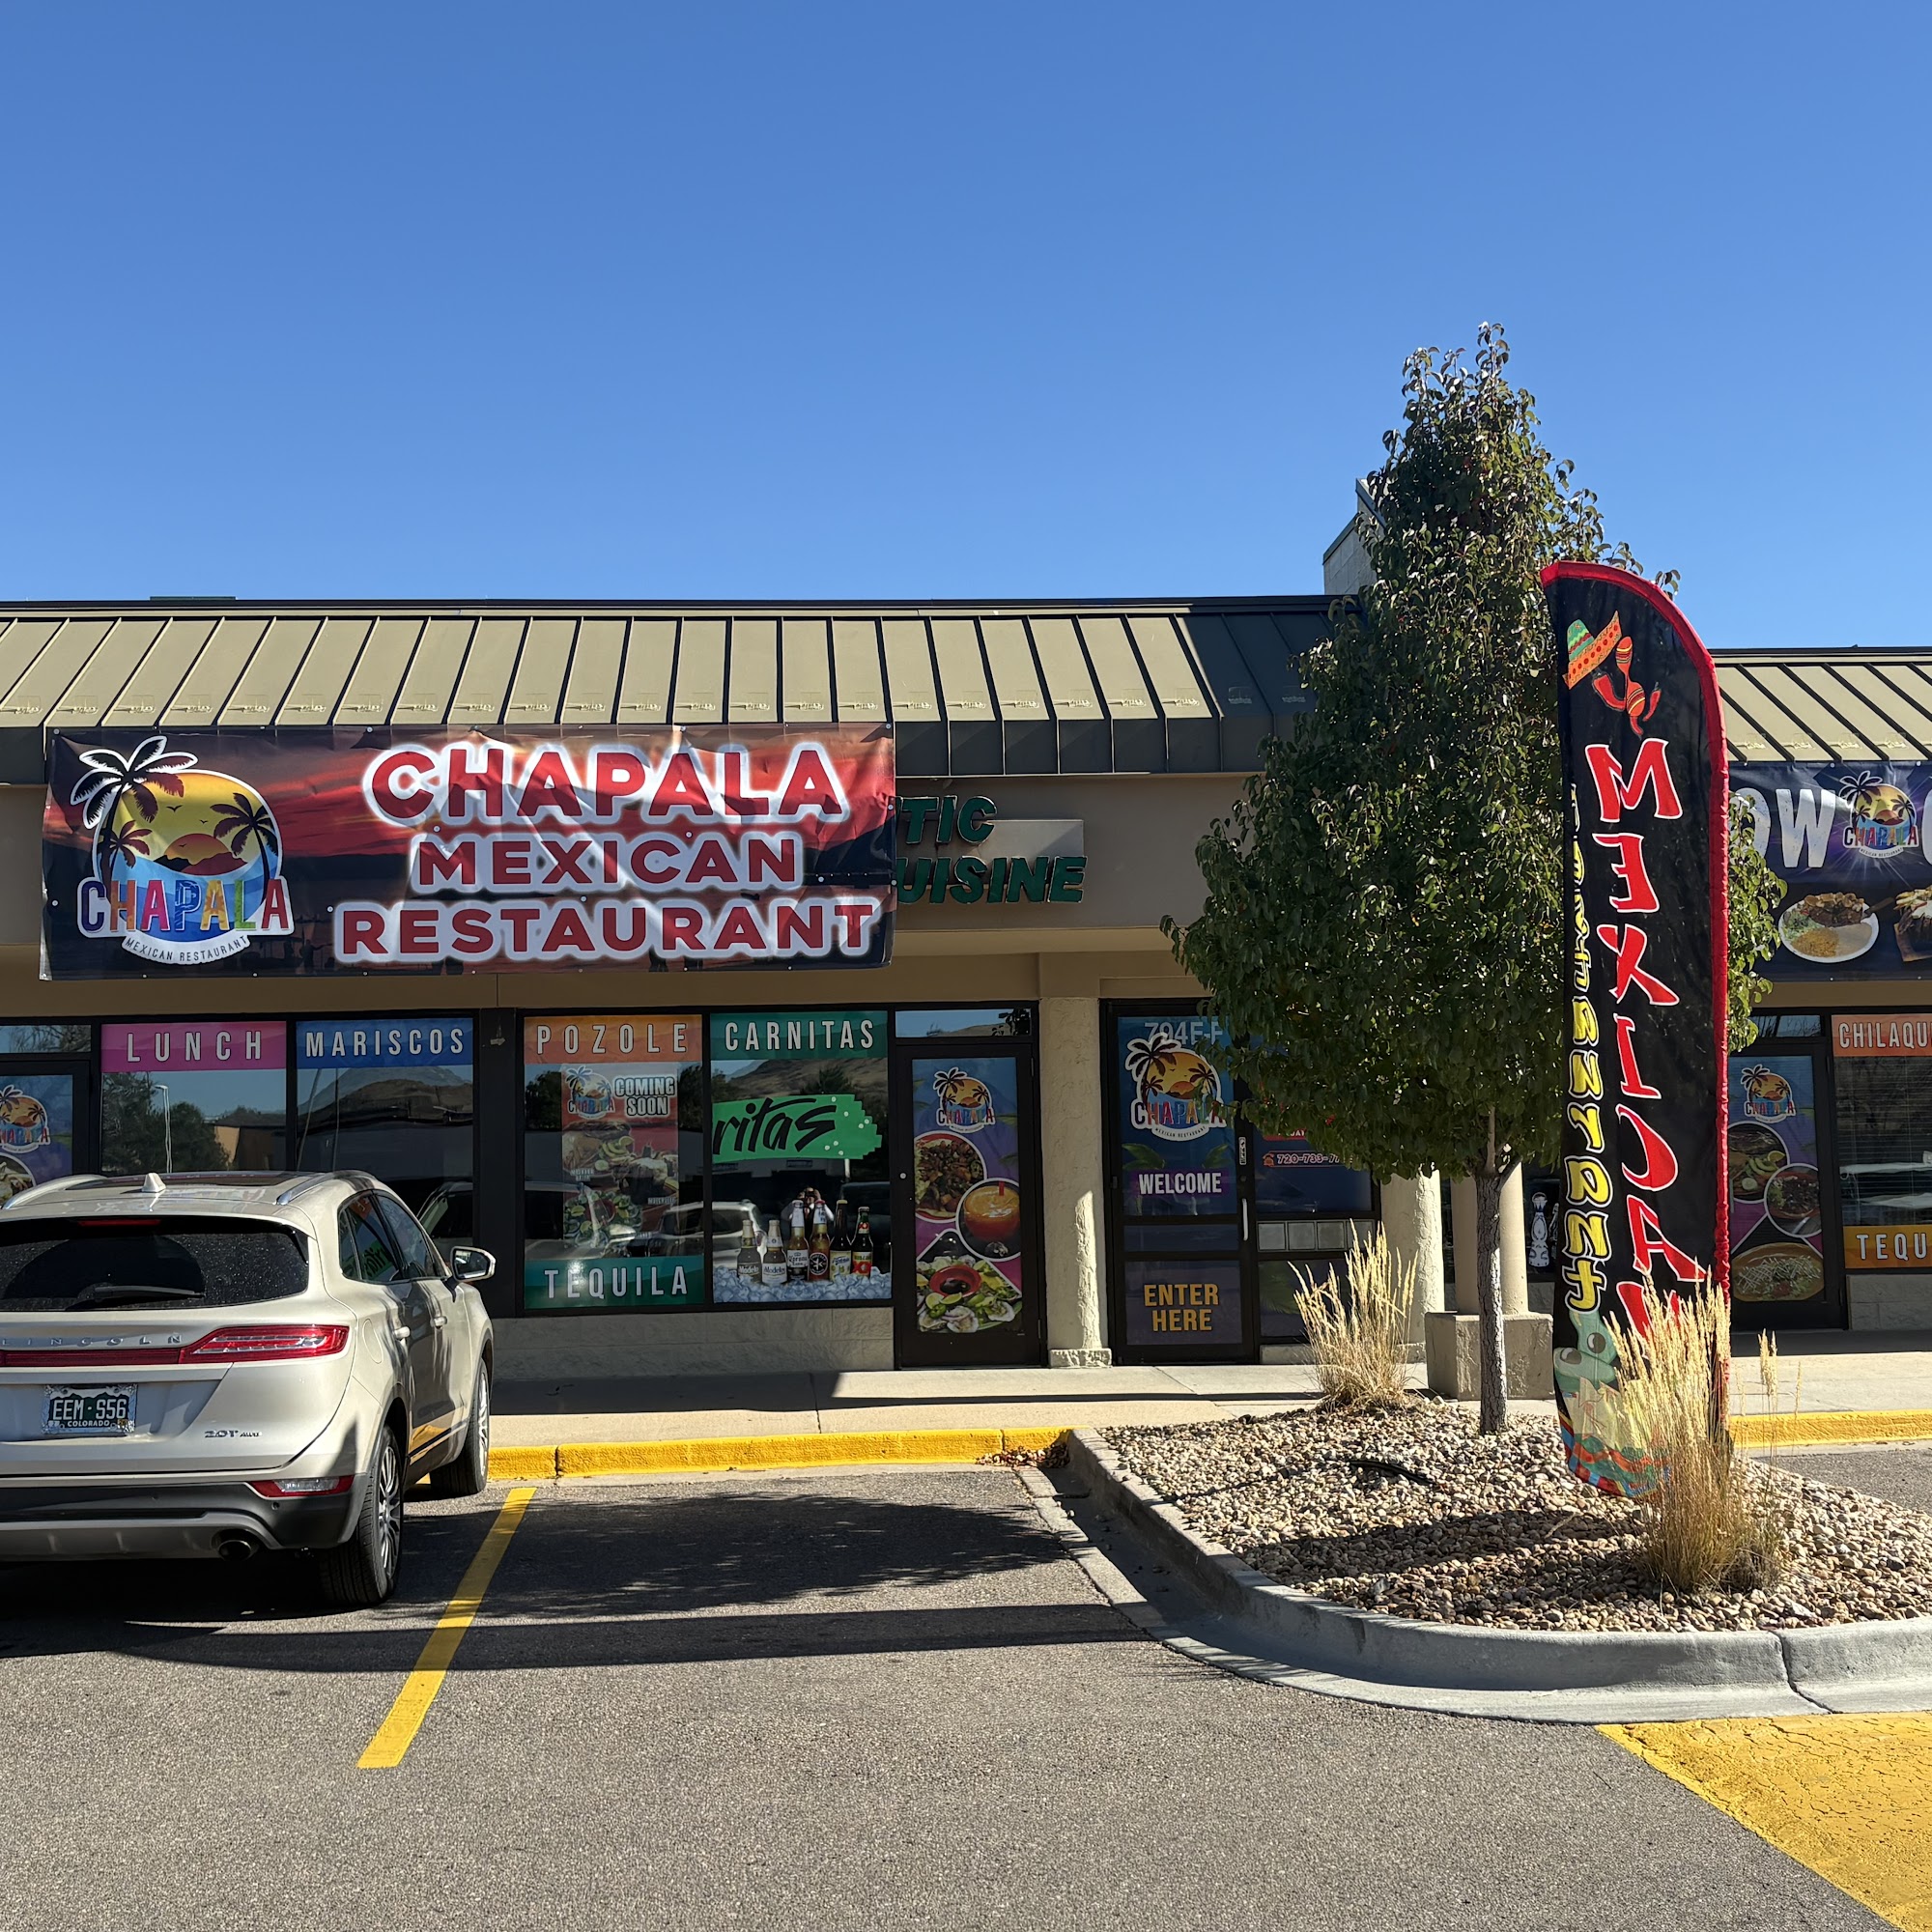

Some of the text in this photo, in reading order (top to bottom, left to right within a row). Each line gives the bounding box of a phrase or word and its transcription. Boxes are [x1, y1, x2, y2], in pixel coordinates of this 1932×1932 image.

[372, 749, 842, 818] CHAPALA
[895, 795, 997, 845] TIC
[1844, 825, 1918, 846] CHAPALA
[419, 838, 795, 885] MEXICAN
[81, 878, 290, 932] CHAPALA
[342, 905, 873, 954] RESTAURANT
[125, 934, 248, 964] MEXICAN RESTAURANT
[127, 1031, 262, 1063] LUNCH
[305, 1028, 465, 1058] MARISCOS
[536, 1023, 688, 1055] POZOLE
[724, 1019, 874, 1051] CARNITAS
[614, 1076, 676, 1097] COMING
[626, 1096, 669, 1117] SOON
[1134, 1100, 1224, 1125] CHAPALA
[712, 1097, 838, 1155] ritas
[1138, 1172, 1223, 1195] WELCOME
[1856, 1233, 1927, 1261] TEQU
[544, 1265, 688, 1299] TEQUILA
[1144, 1283, 1219, 1307] ENTER
[1151, 1309, 1213, 1332] HERE
[2, 1333, 182, 1348] LINCOLN
